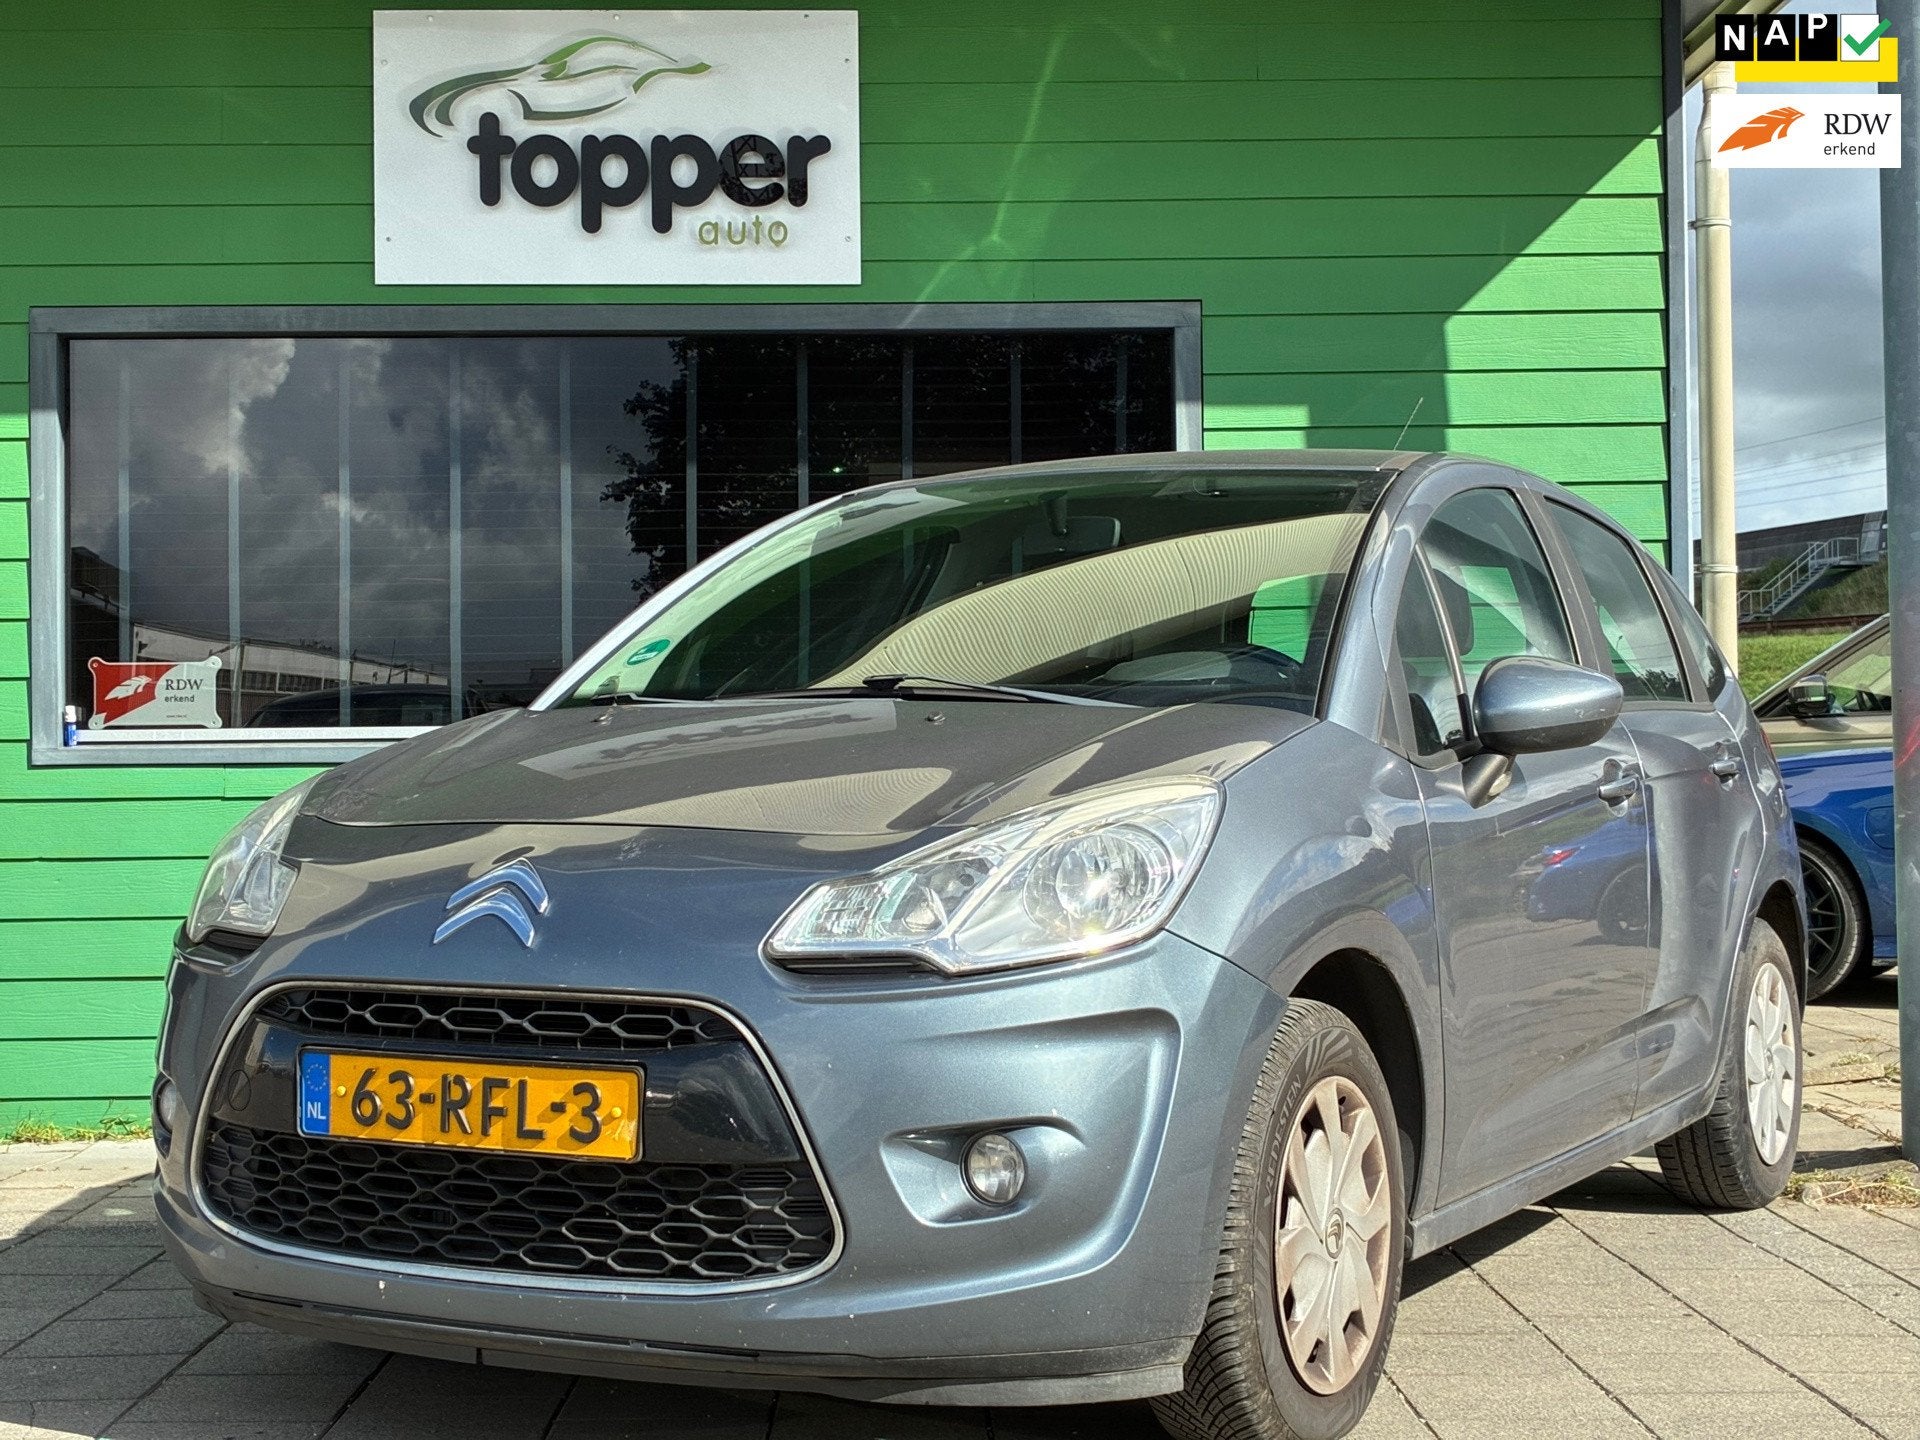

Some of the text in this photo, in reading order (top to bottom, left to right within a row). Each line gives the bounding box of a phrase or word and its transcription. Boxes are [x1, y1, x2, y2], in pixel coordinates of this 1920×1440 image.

[467, 112, 832, 234] topper
[698, 214, 789, 247] auto
[165, 678, 203, 691] RDW
[164, 694, 195, 703] erkend
[307, 1101, 327, 1120] NL
[351, 1067, 602, 1143] 63-RFL-3
